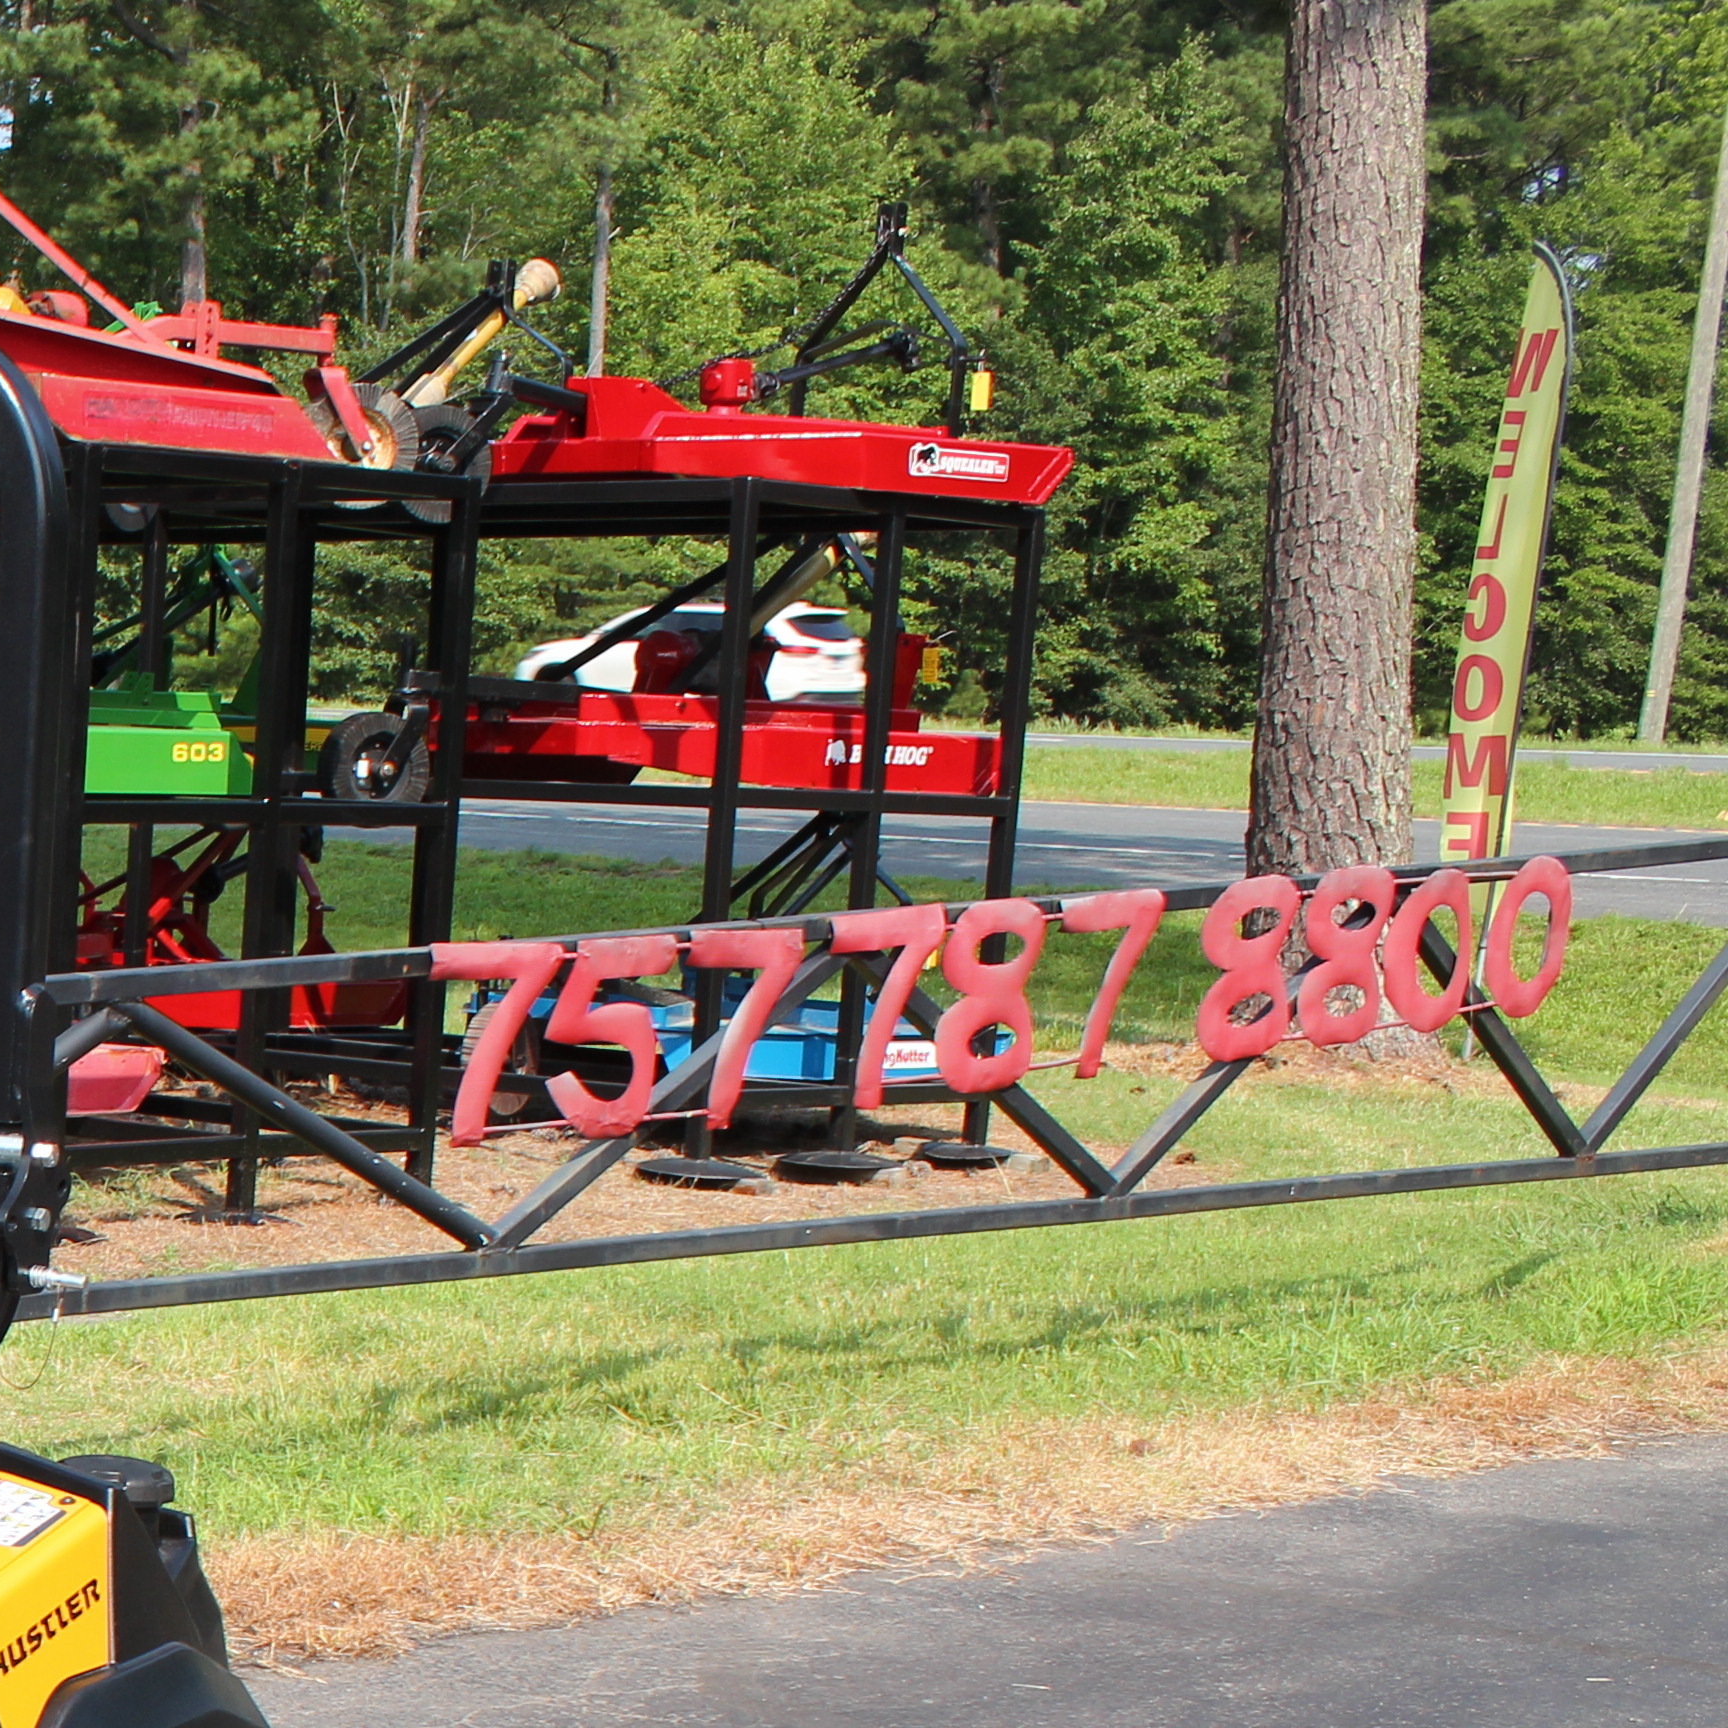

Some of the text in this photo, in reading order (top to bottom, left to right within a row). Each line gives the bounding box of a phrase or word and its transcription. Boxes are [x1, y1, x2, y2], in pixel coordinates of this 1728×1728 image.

[171, 741, 226, 763] 603
[892, 745, 929, 766] HOG
[429, 855, 1573, 1147] 757 787 8800
